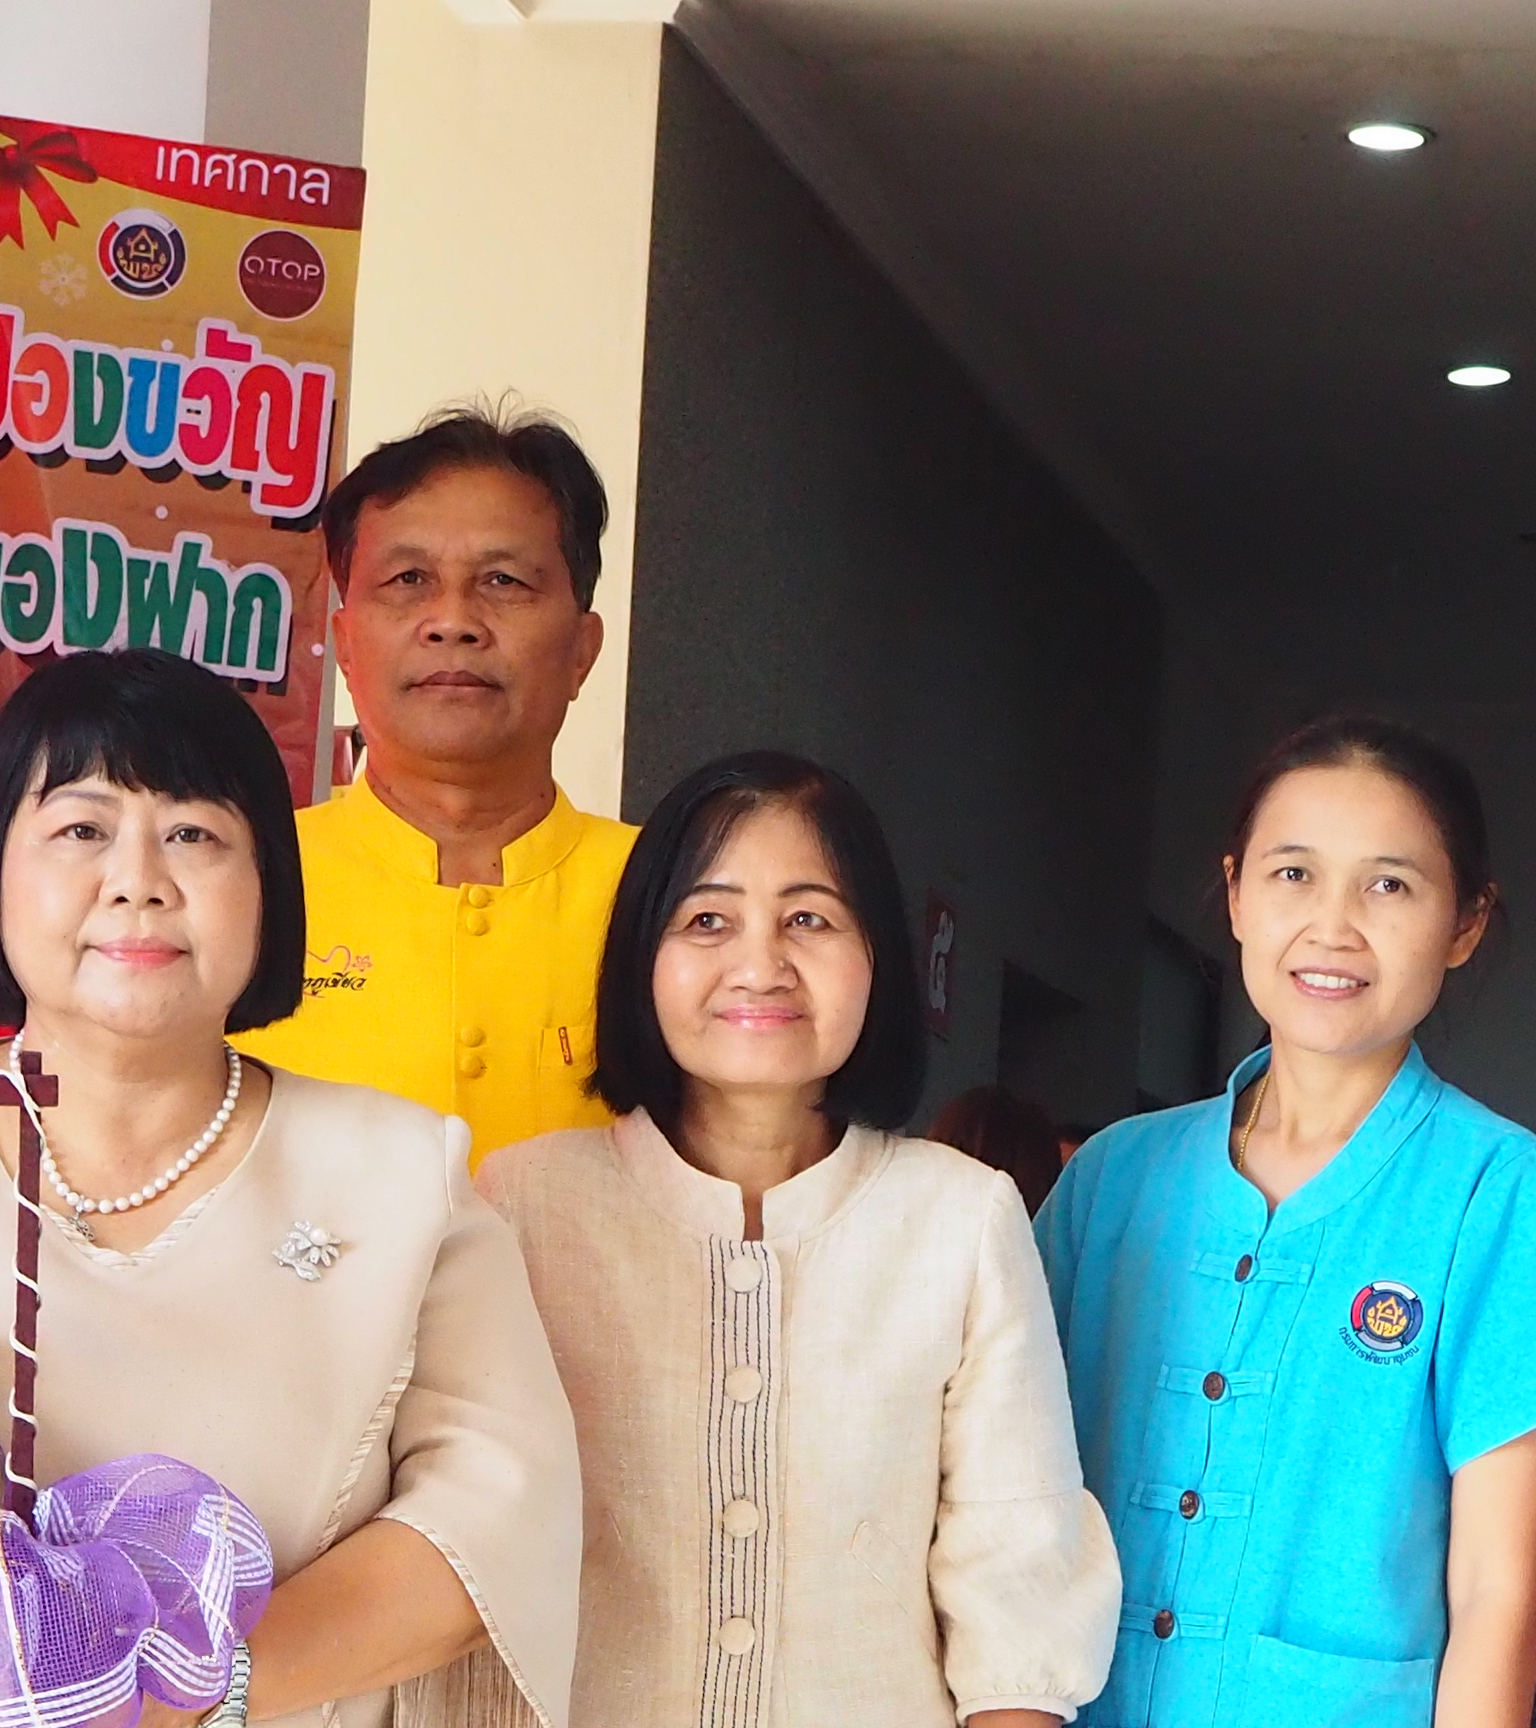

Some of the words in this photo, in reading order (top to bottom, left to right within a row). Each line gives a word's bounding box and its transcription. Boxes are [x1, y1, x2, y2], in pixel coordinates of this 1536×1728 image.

[154, 144, 332, 206] เทศกาล
[244, 256, 321, 281] OTOP
